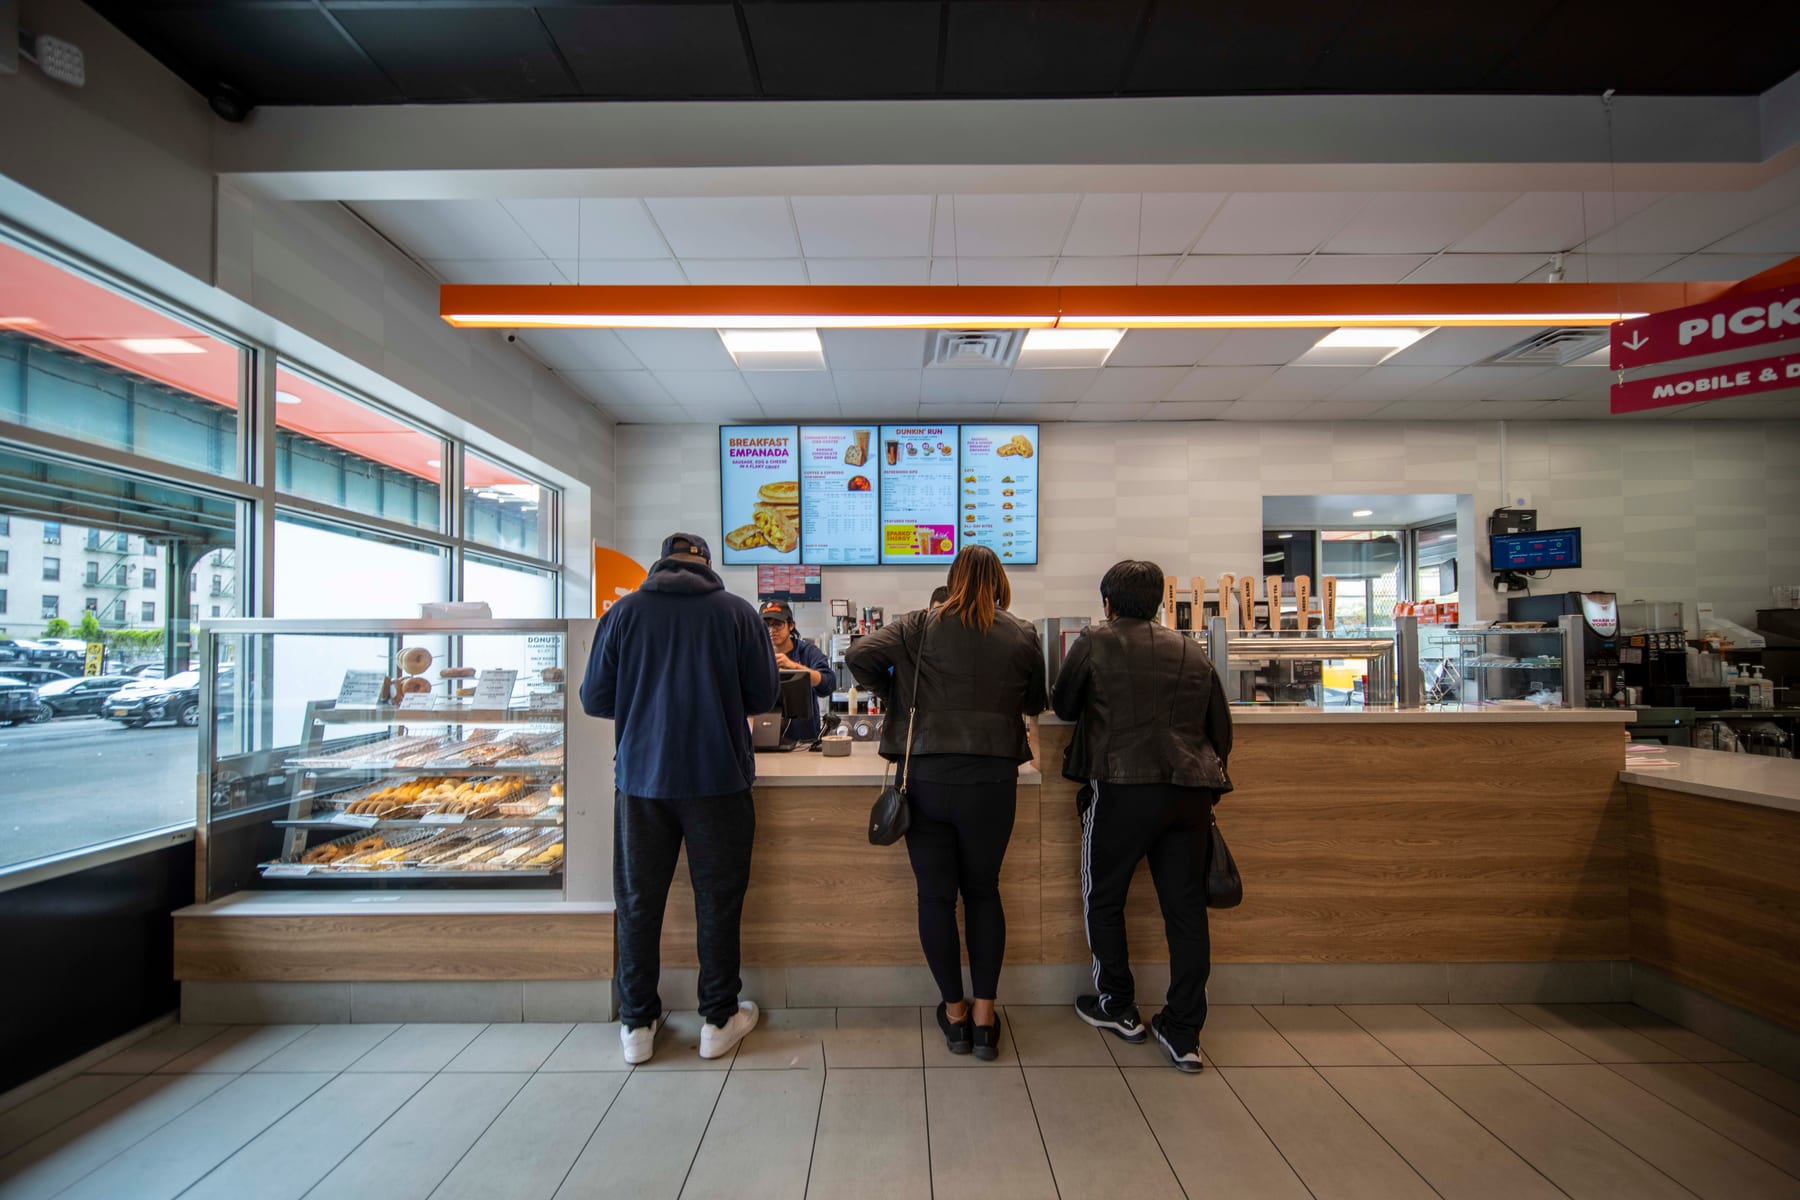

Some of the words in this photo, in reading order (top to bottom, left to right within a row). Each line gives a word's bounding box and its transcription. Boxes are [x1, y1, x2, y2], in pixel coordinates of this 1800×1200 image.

[1679, 298, 1800, 346] PICK
[1652, 371, 1751, 399] MOBILE
[1758, 368, 1778, 382] &
[729, 438, 789, 447] BREAKFAST
[729, 448, 789, 457] EMPANADA
